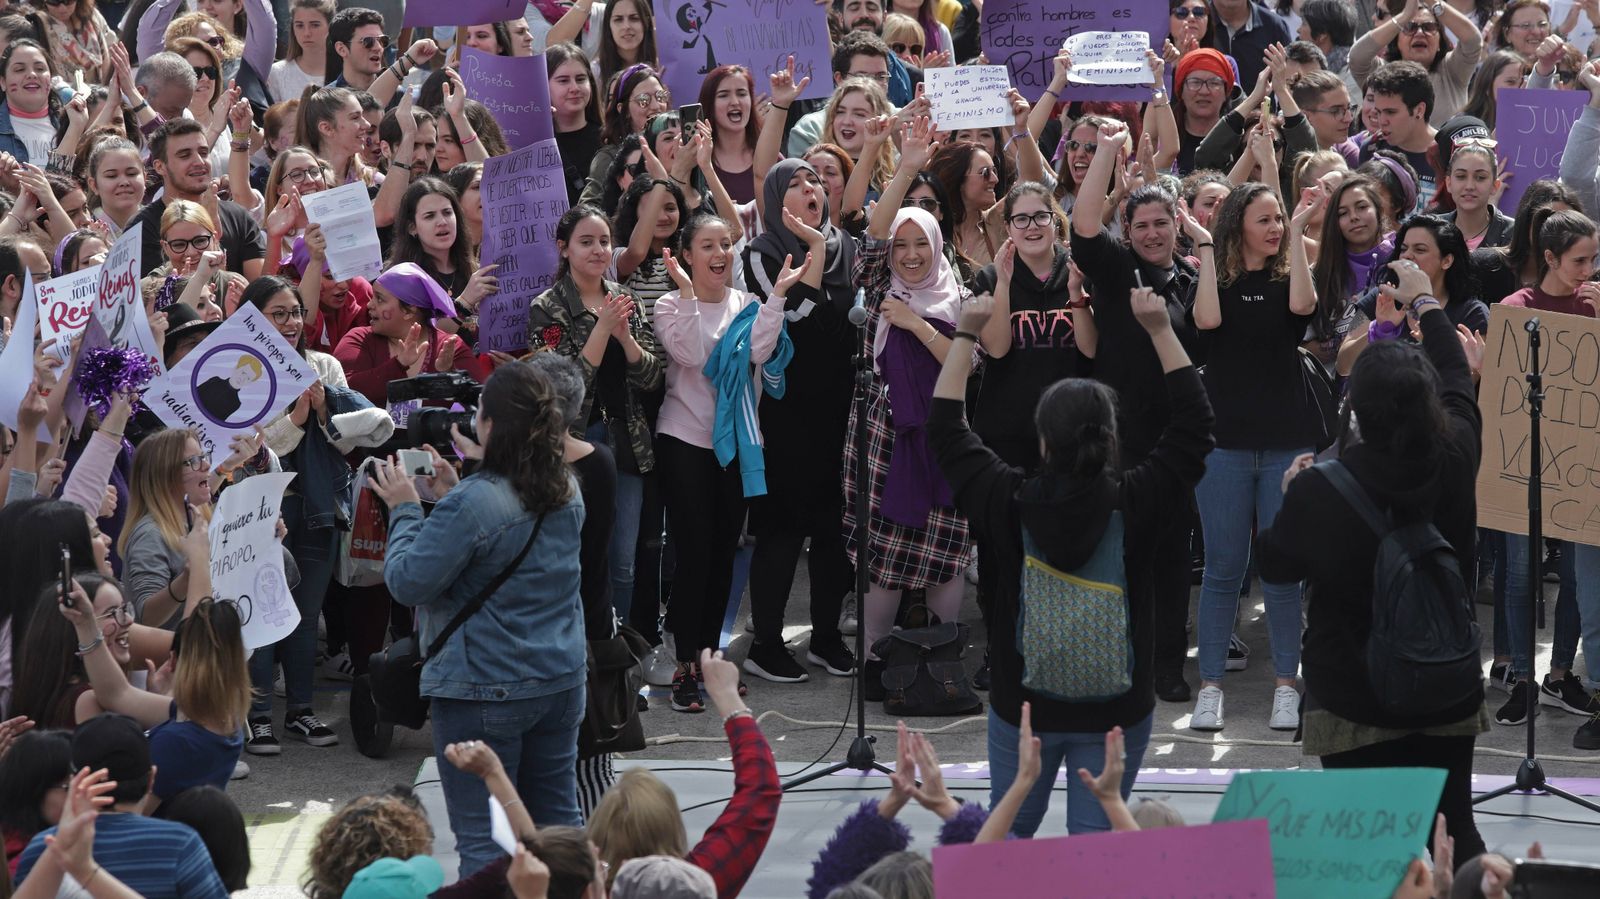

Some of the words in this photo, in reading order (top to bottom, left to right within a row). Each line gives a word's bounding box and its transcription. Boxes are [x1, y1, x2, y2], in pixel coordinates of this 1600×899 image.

[986, 2, 1032, 25] contra
[1041, 5, 1096, 22] hombres
[1112, 8, 1131, 18] es
[954, 68, 971, 76] ERES
[1077, 66, 1142, 77] FEMINISMO
[944, 79, 970, 88] PUEDES
[936, 106, 1004, 122] FEMINISMO
[520, 223, 540, 245] QUE
[512, 296, 524, 311] NO
[488, 332, 503, 350] NO
[255, 331, 286, 365] piropos
[285, 364, 304, 382] son
[256, 496, 274, 522] tu
[352, 538, 387, 553] sup
